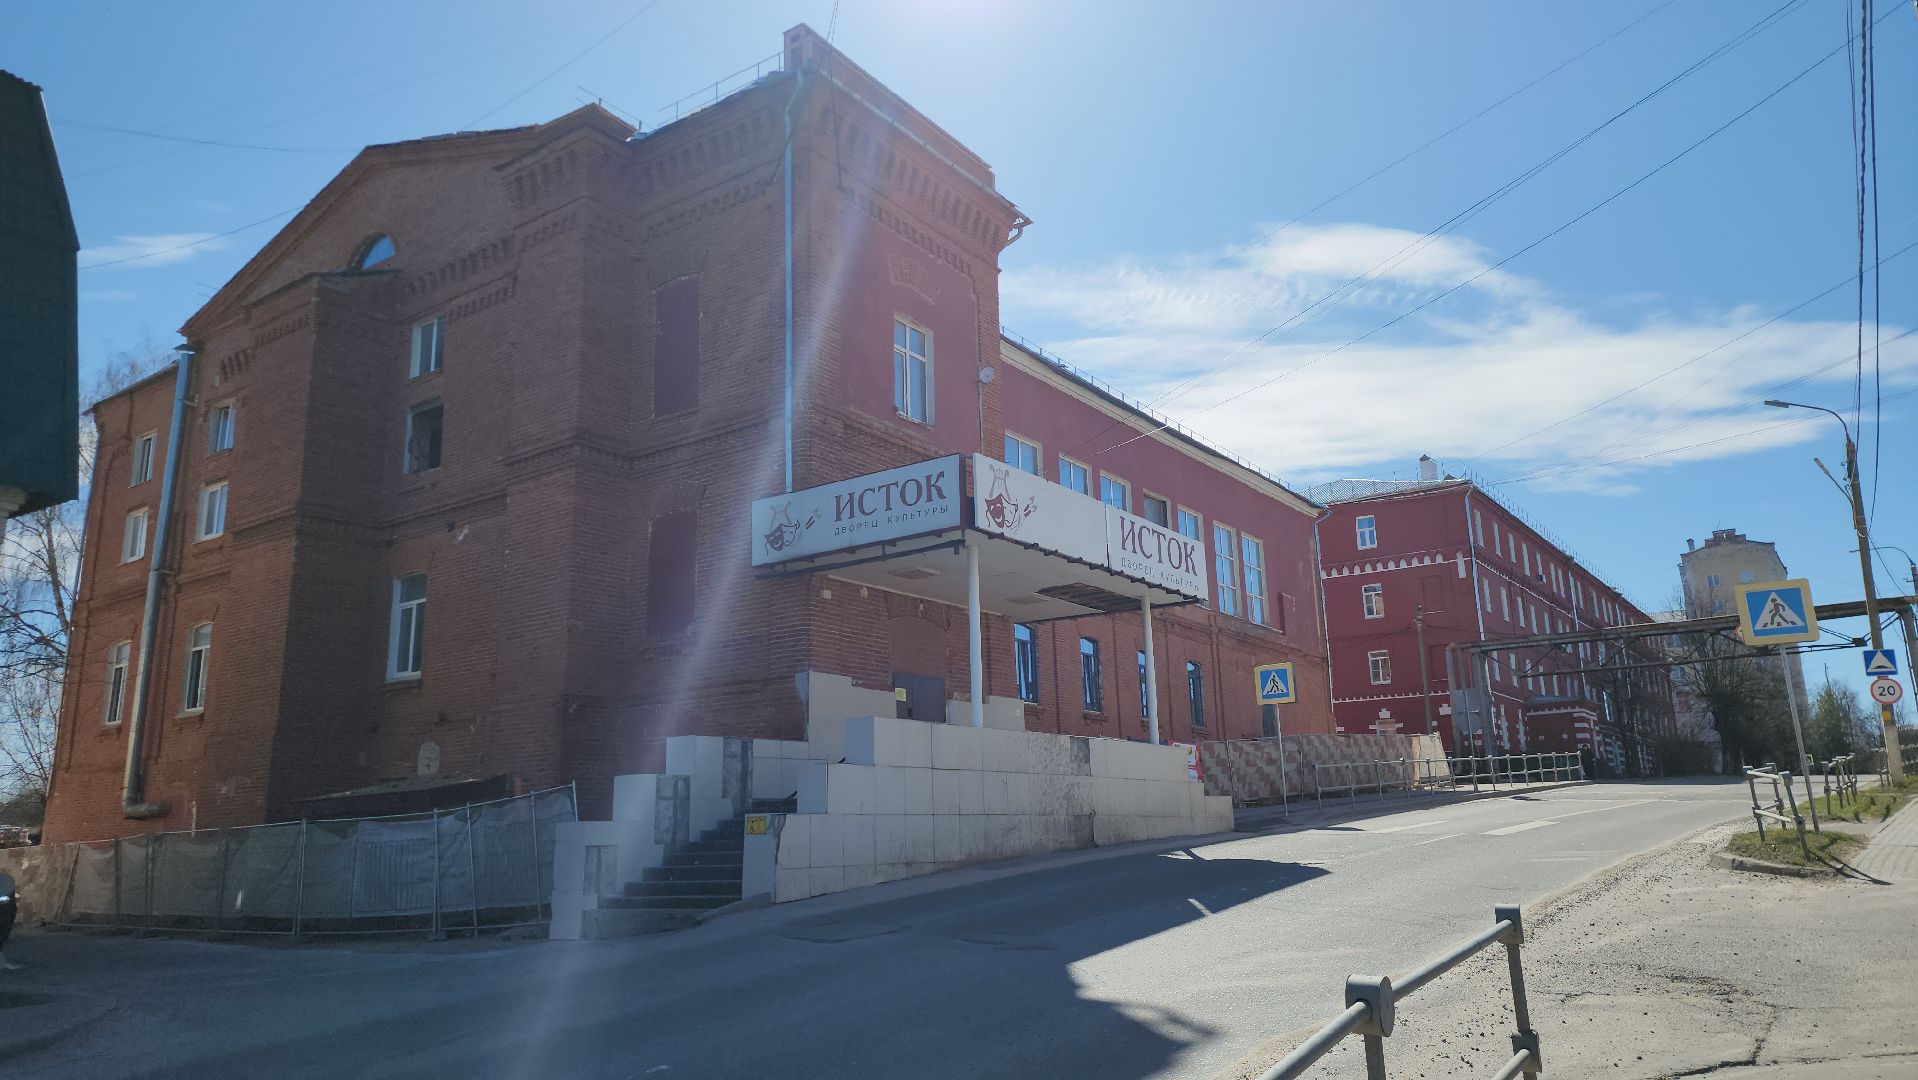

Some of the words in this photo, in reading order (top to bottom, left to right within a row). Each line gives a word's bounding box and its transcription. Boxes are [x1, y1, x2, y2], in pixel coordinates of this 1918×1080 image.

[834, 471, 947, 522] ИСТОК
[834, 519, 878, 536] ДВОРЕЦ
[887, 505, 948, 525] КУЛЬТУРЫ
[1120, 515, 1198, 576] ИСТОК
[1878, 685, 1896, 697] 20
